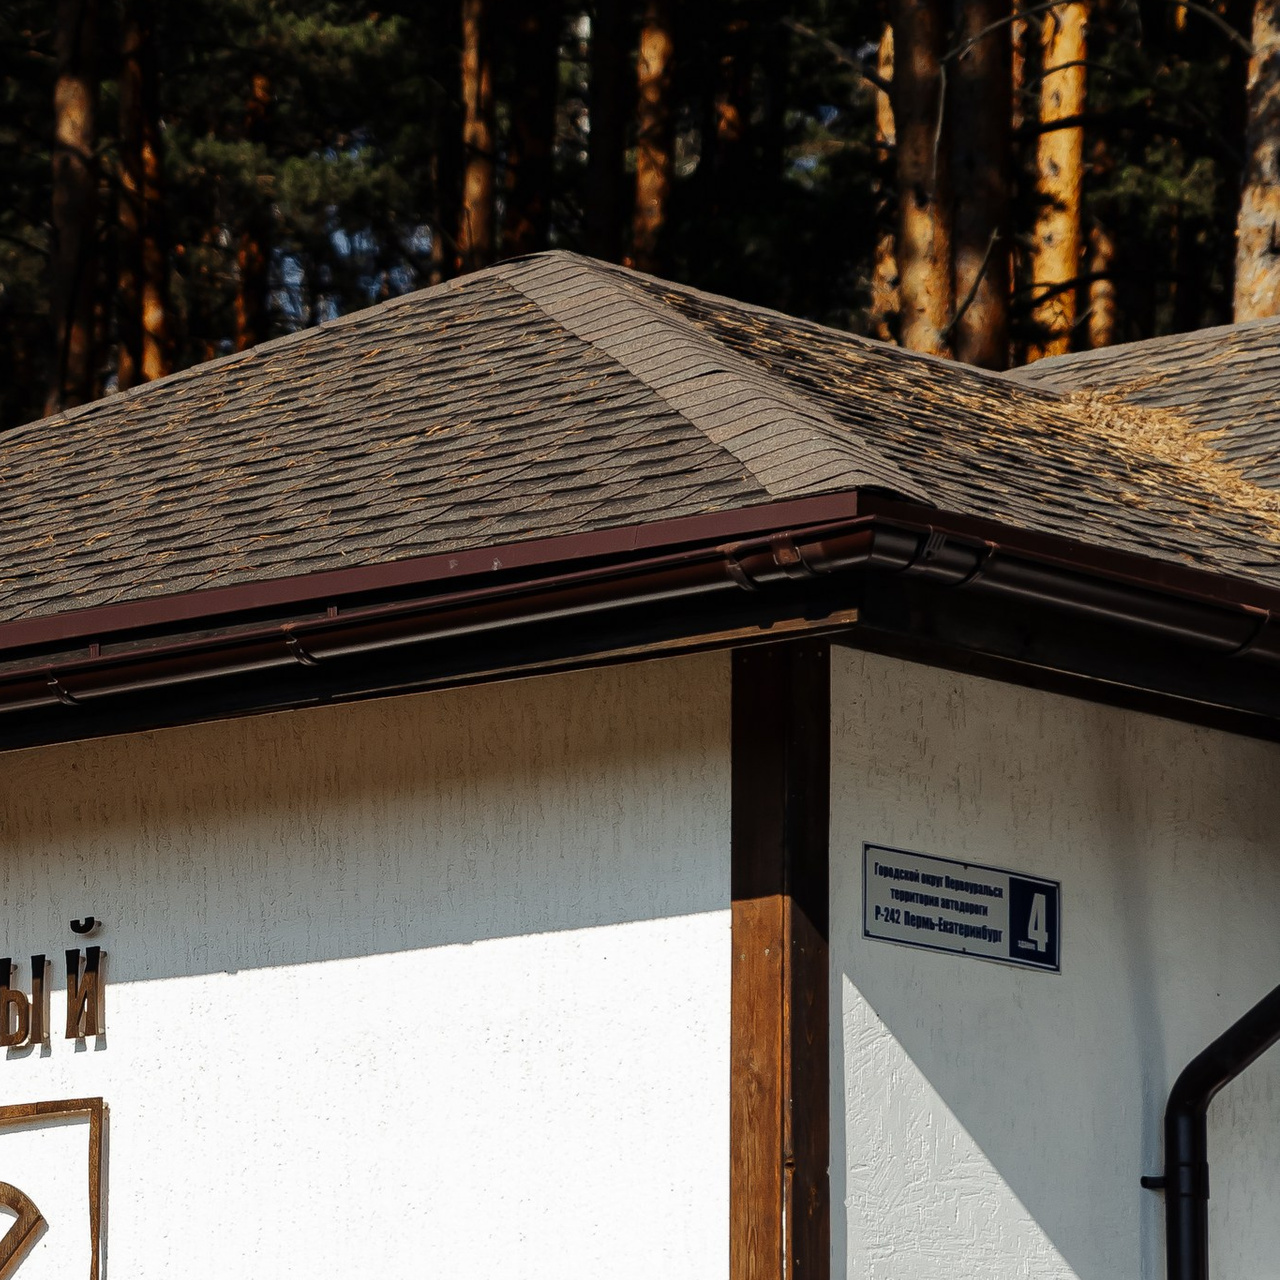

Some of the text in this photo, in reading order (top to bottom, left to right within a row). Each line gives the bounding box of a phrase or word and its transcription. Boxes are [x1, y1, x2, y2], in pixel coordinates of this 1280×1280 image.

[874, 862, 1003, 898] Городской округ Первоуральск
[890, 887, 988, 917] территория автодороги
[874, 905, 1003, 943] Р-242 Пермь-Екатеринбург
[1028, 892, 1048, 952] 4
